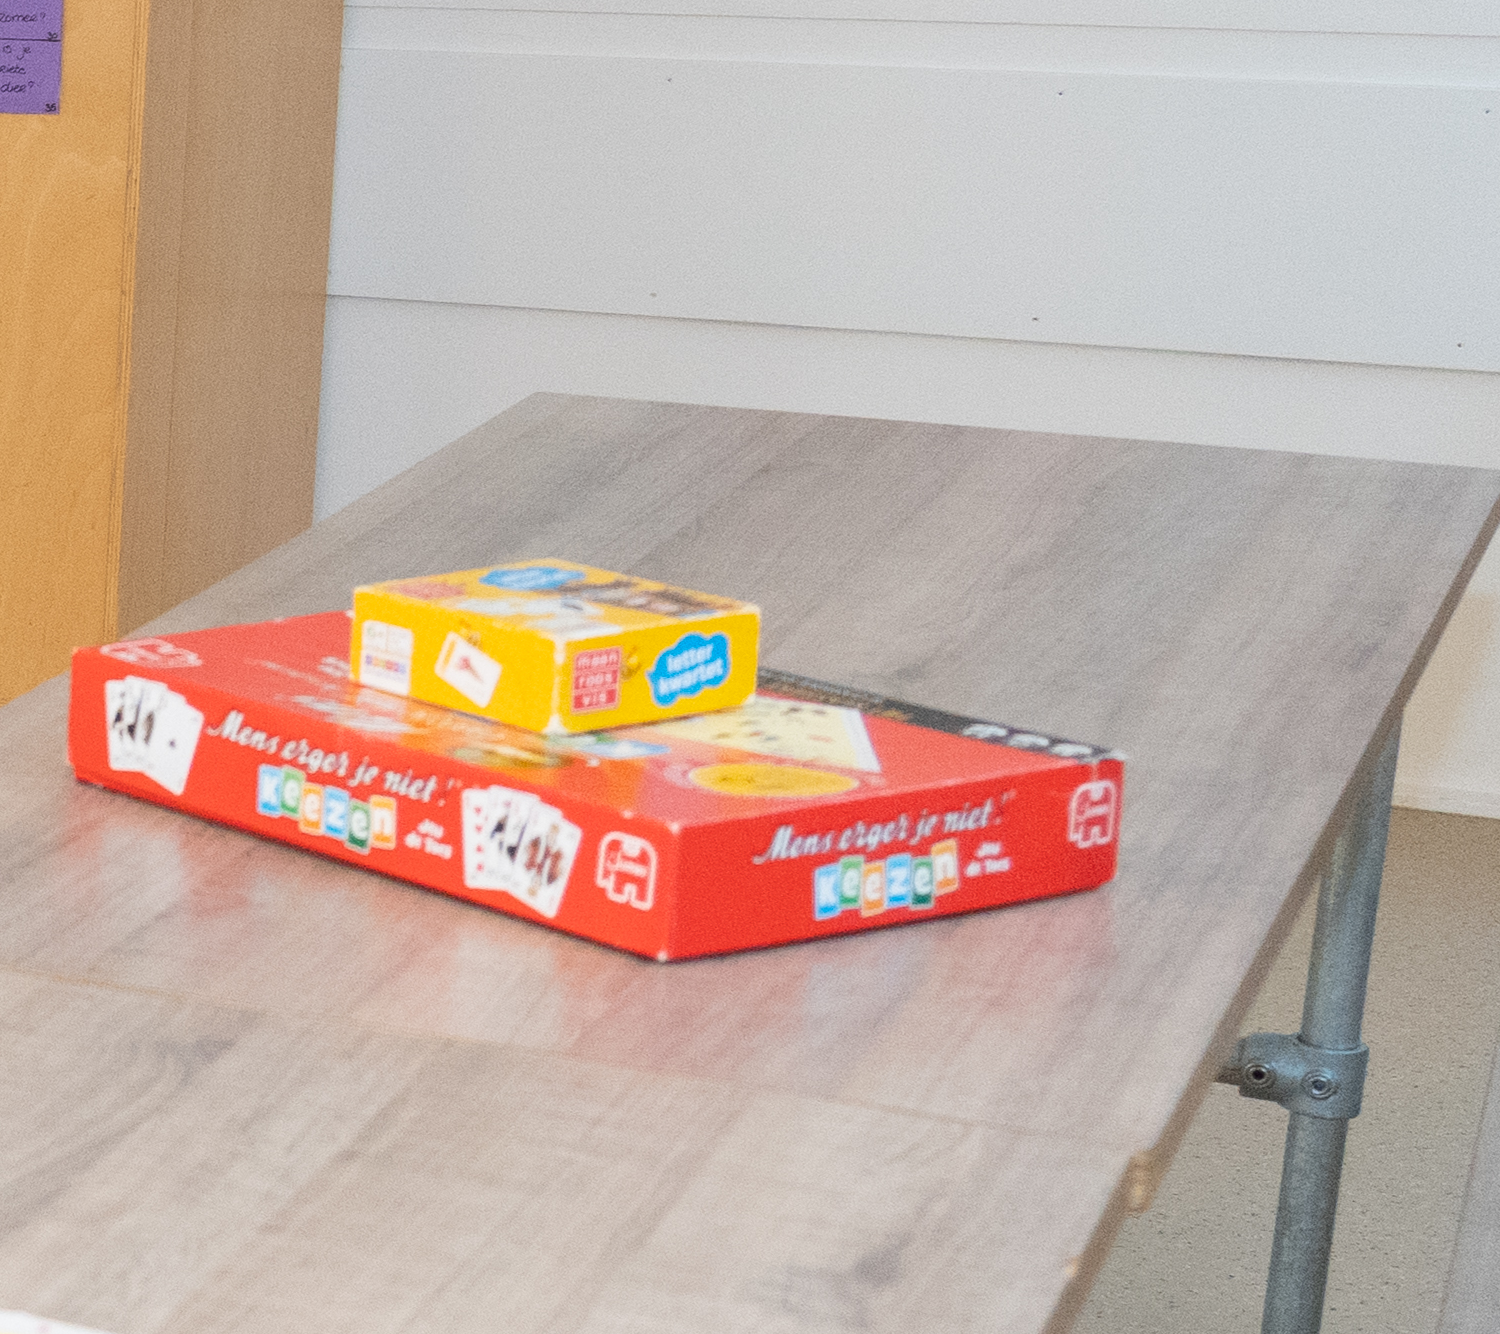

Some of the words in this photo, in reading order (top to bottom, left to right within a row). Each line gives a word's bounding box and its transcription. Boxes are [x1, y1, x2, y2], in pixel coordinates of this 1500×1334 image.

[206, 710, 280, 754] Mens
[348, 756, 379, 787] je
[752, 824, 835, 865] Mens
[908, 808, 938, 846] je
